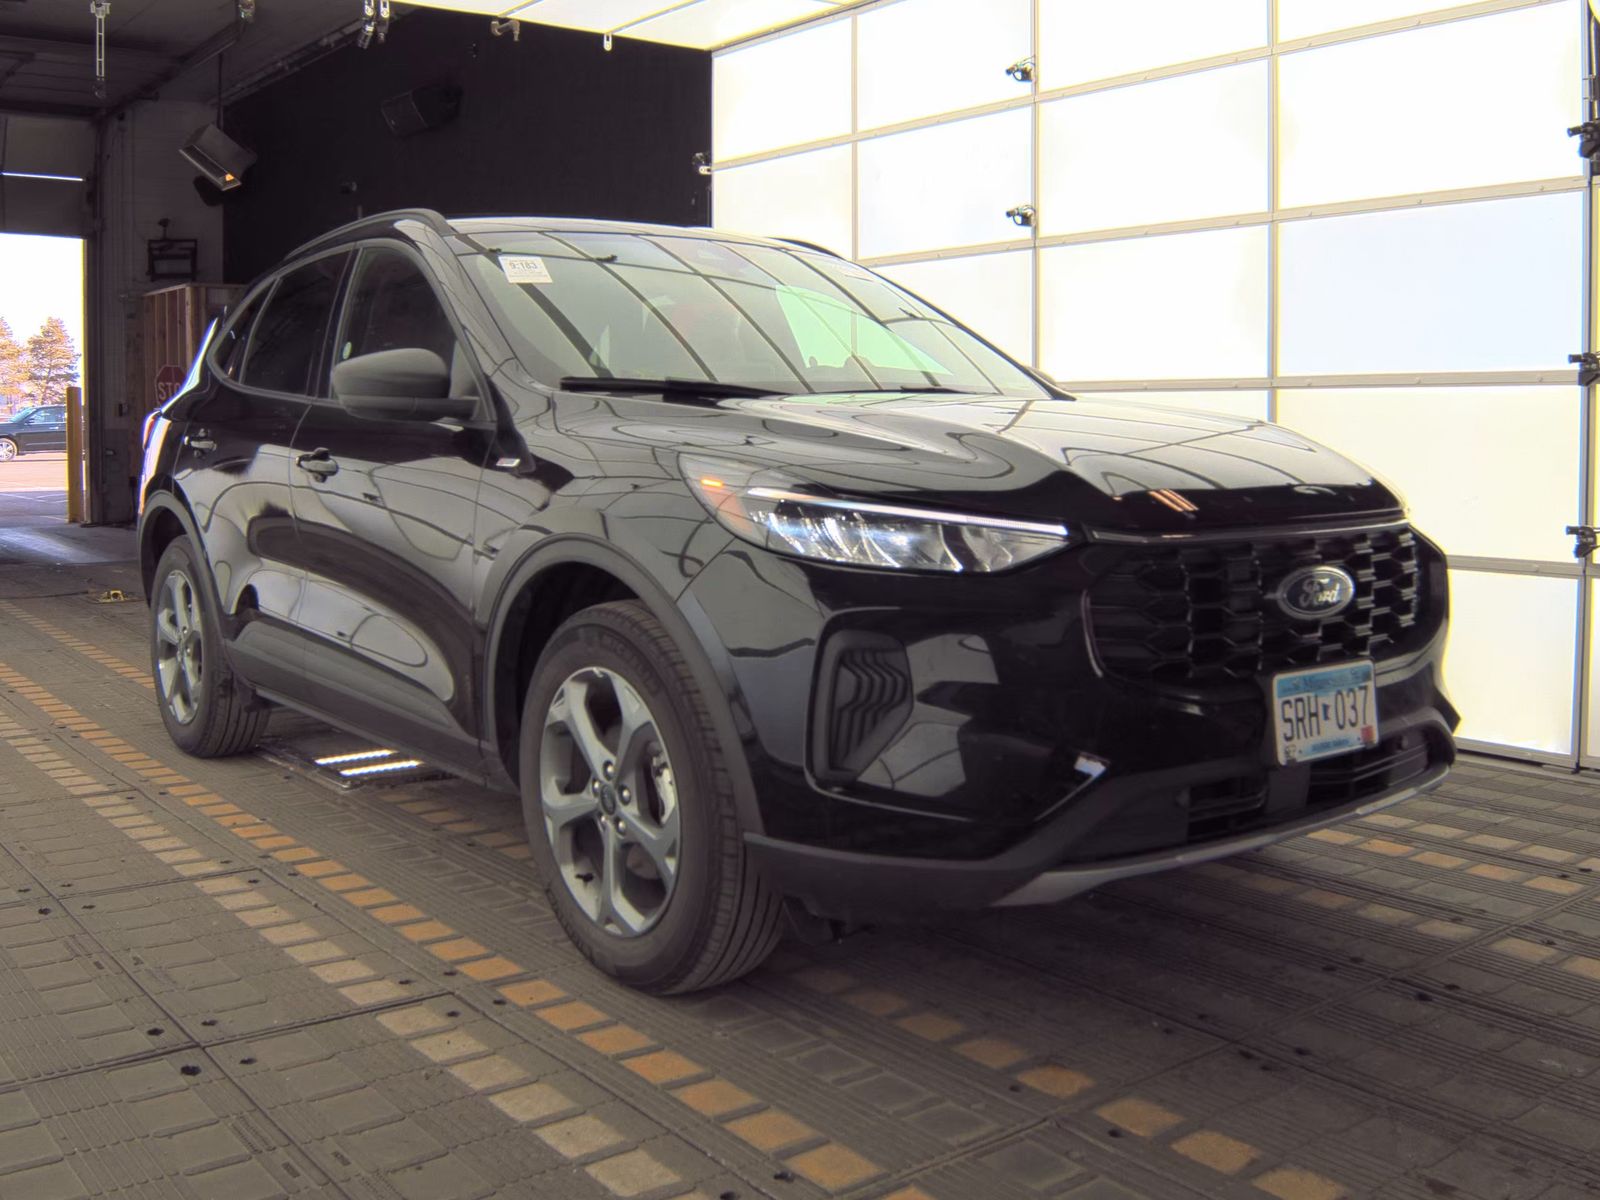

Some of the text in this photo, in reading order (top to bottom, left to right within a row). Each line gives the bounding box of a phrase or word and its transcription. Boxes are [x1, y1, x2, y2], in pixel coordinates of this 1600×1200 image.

[1300, 579, 1339, 608] Ford
[1281, 684, 1368, 742] SRH 037
